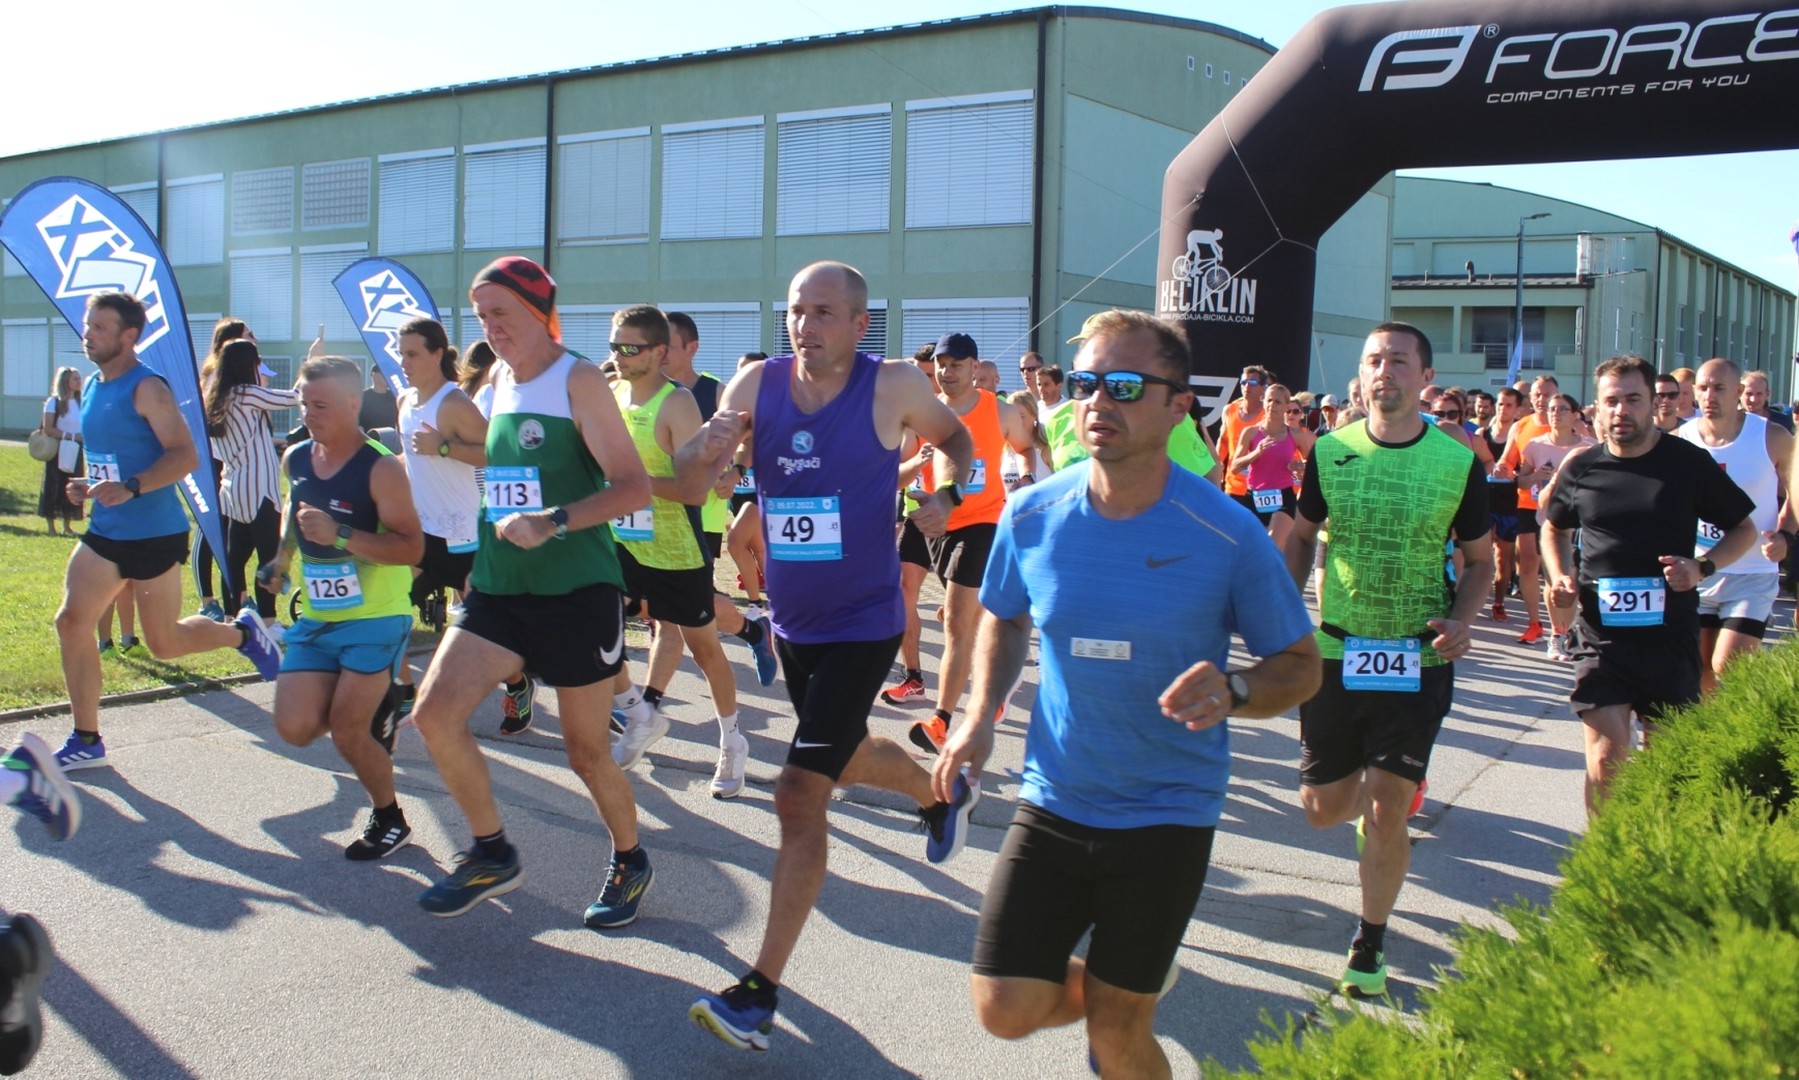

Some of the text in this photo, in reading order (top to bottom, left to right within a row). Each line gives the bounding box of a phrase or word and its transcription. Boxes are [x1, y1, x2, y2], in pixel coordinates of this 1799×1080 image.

[1485, 9, 1799, 84] FORCE
[1487, 74, 1751, 104] COMPONENTS FOR YOU
[493, 482, 529, 506] 113
[1258, 495, 1277, 506] 101
[781, 515, 815, 543] 49
[310, 578, 349, 598] 126
[1609, 590, 1651, 613] 291
[1356, 651, 1407, 675] 204
